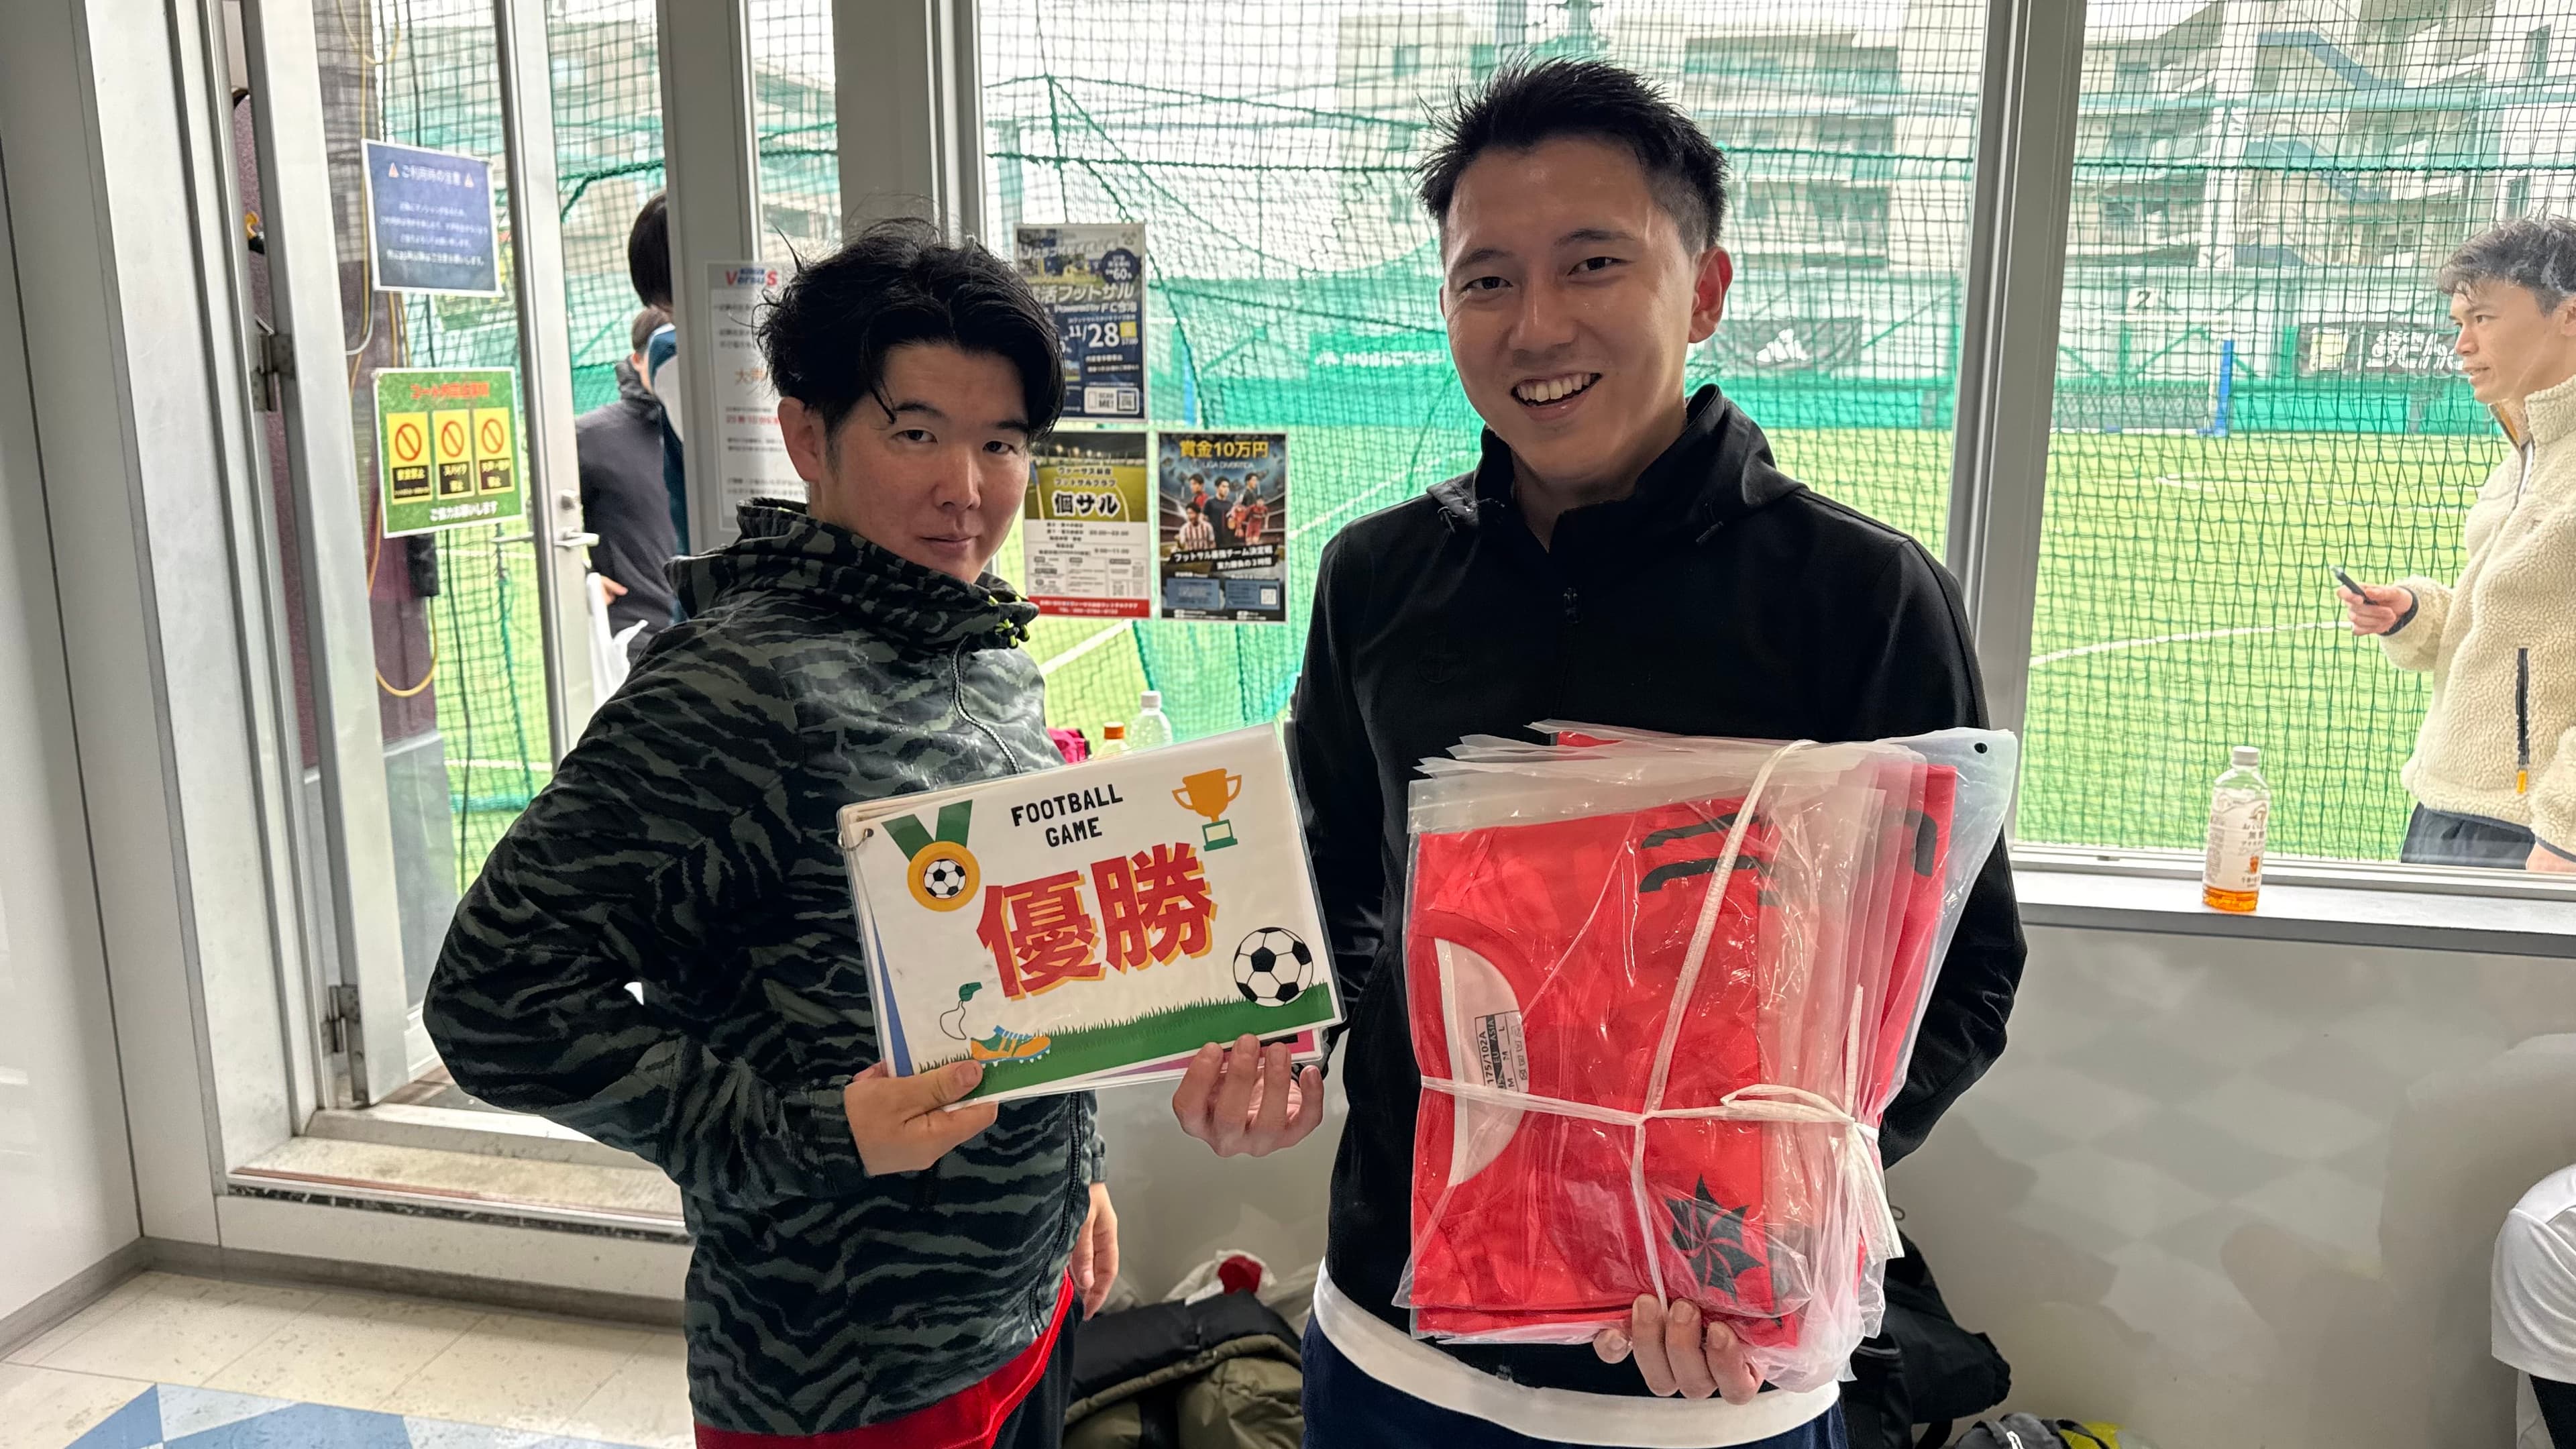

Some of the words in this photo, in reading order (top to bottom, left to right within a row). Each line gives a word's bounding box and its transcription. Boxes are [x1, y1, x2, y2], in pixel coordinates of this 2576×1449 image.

[1179, 440, 1269, 458] 賞金10万円
[1054, 493, 1118, 515] 個サル
[1010, 783, 1123, 826] FOOTBALL
[1045, 816, 1102, 847] GAME
[976, 842, 1220, 1001] 優勝
[1487, 1020, 1497, 1040] ASIA
[1479, 1031, 1494, 1084] 175/102A
[1491, 1051, 1500, 1063] EU
